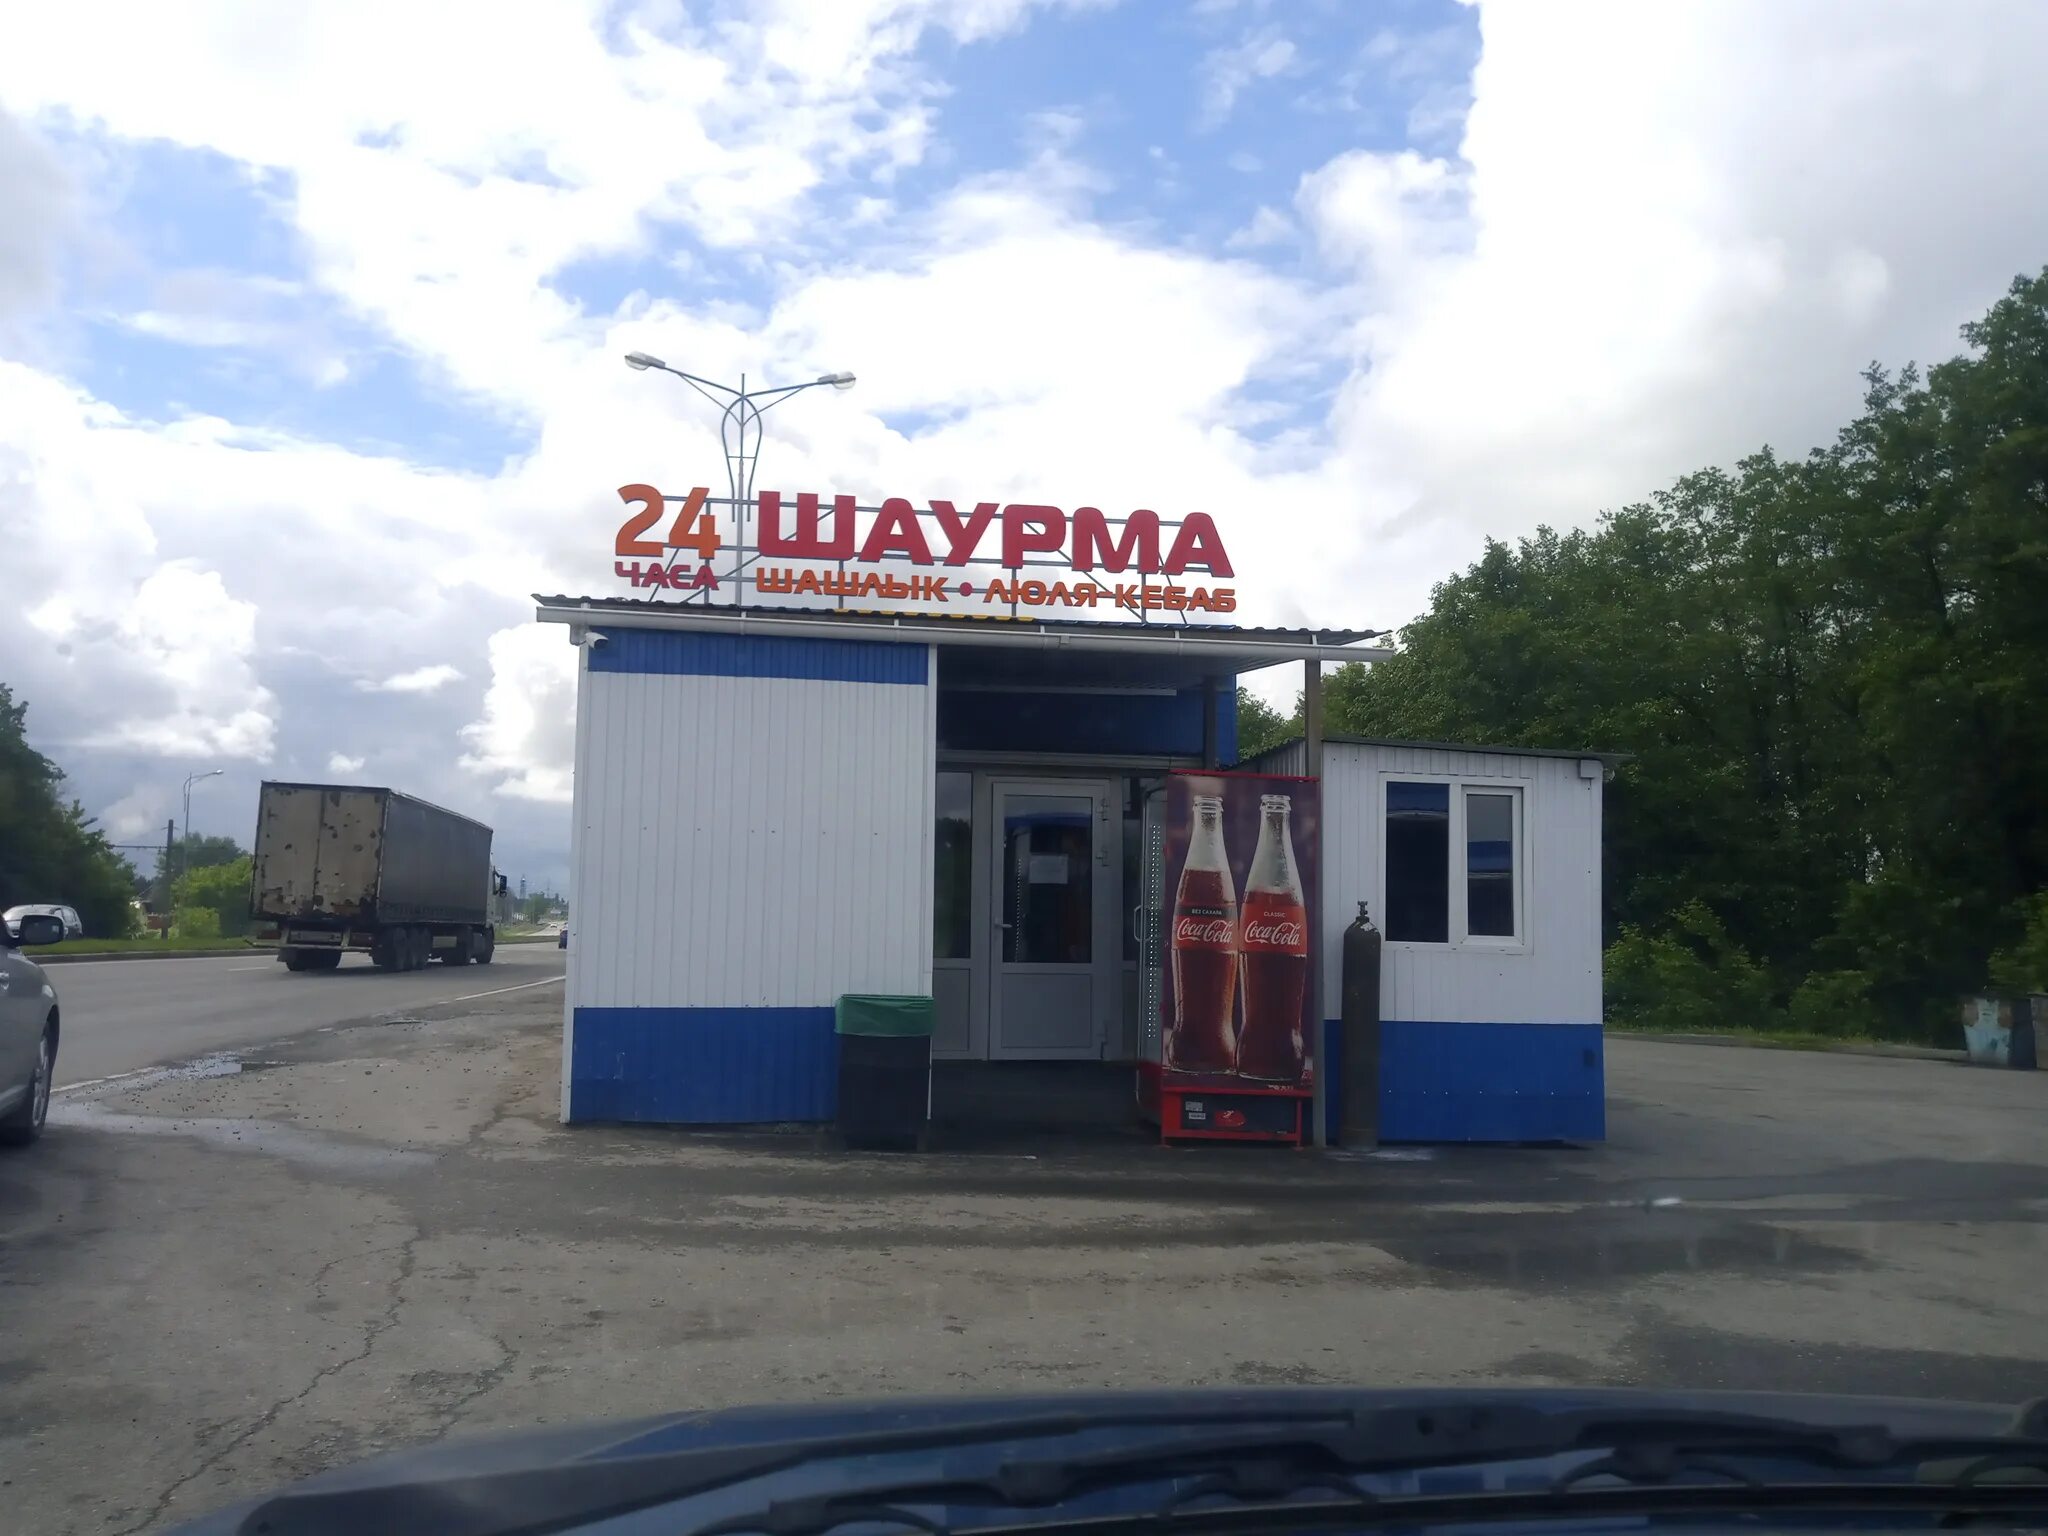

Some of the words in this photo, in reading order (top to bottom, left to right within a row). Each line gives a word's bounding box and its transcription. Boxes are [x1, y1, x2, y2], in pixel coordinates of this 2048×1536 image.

[615, 484, 721, 560] 24
[758, 490, 1236, 578] ШАУРМА
[615, 561, 720, 591] ЧАСА
[756, 567, 949, 603] ШАШЛЫК
[983, 578, 1237, 613] ЛЮЛЯ-КЕБАБ
[1177, 918, 1233, 943] Coca-Cola
[1244, 920, 1301, 945] Coca-Cola
